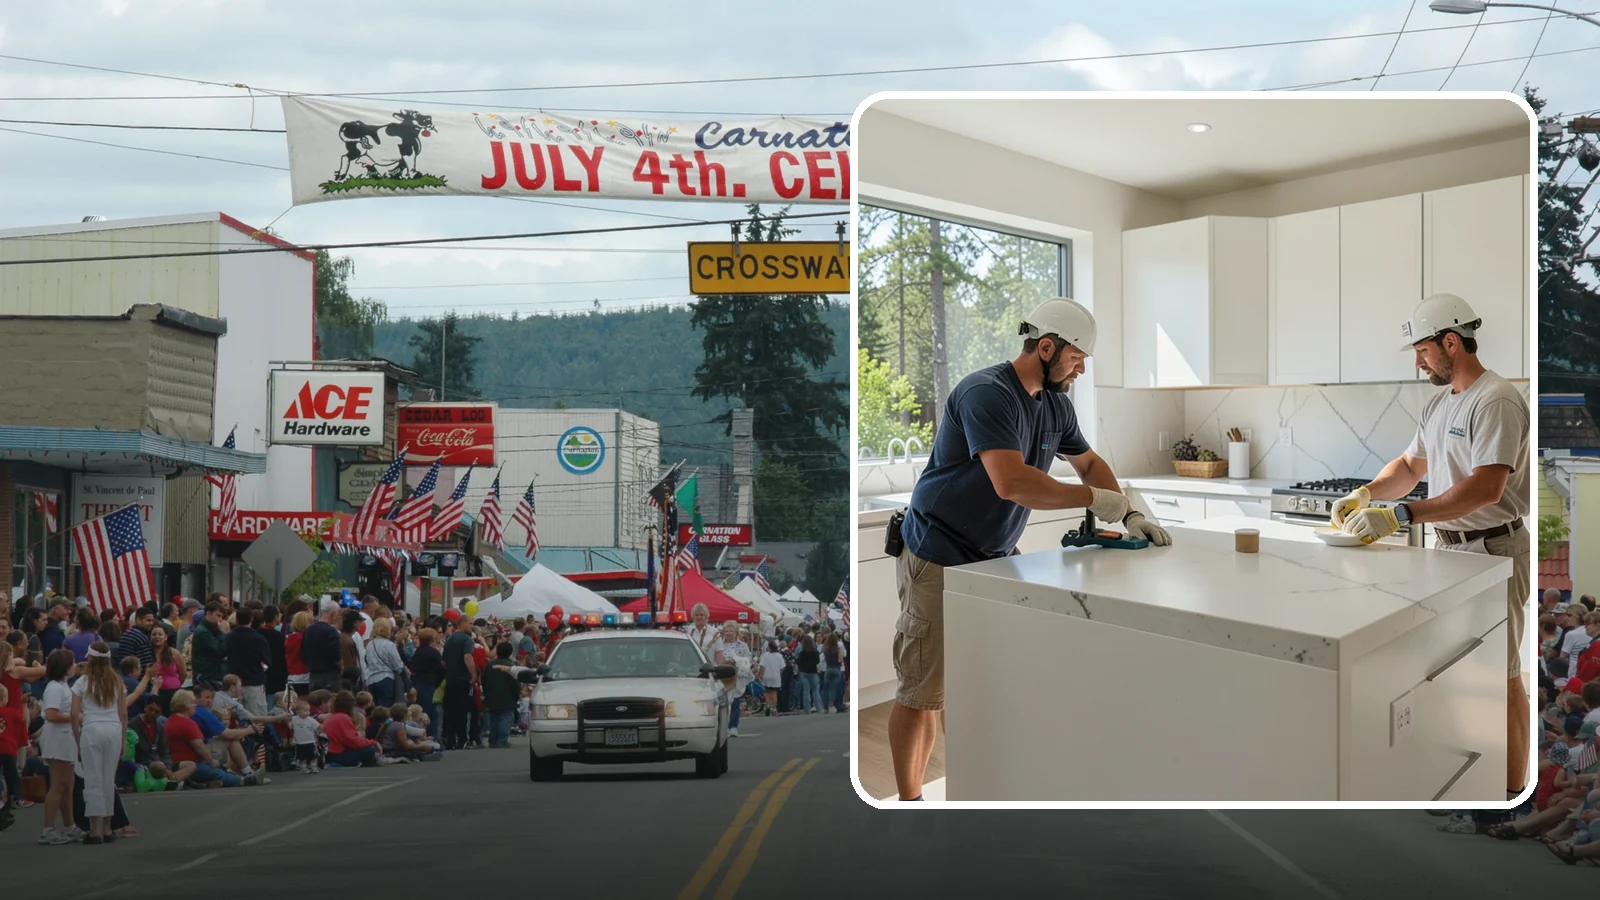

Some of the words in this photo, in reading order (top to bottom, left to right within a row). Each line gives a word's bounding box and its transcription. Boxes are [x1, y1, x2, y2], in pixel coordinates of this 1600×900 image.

[695, 121, 850, 150] Carnat
[481, 140, 605, 192] JULY
[632, 149, 746, 198] 4th.
[697, 254, 850, 280] CROSSWA
[283, 380, 373, 420] ACE
[406, 409, 452, 422] CEDAR
[283, 421, 370, 436] Hardware
[416, 428, 476, 447] Coca-Cola
[96, 486, 124, 494] Vincent
[126, 486, 135, 494] de
[138, 486, 155, 495] Paul
[688, 526, 742, 535] CRNATION
[699, 535, 730, 543] GLASS
